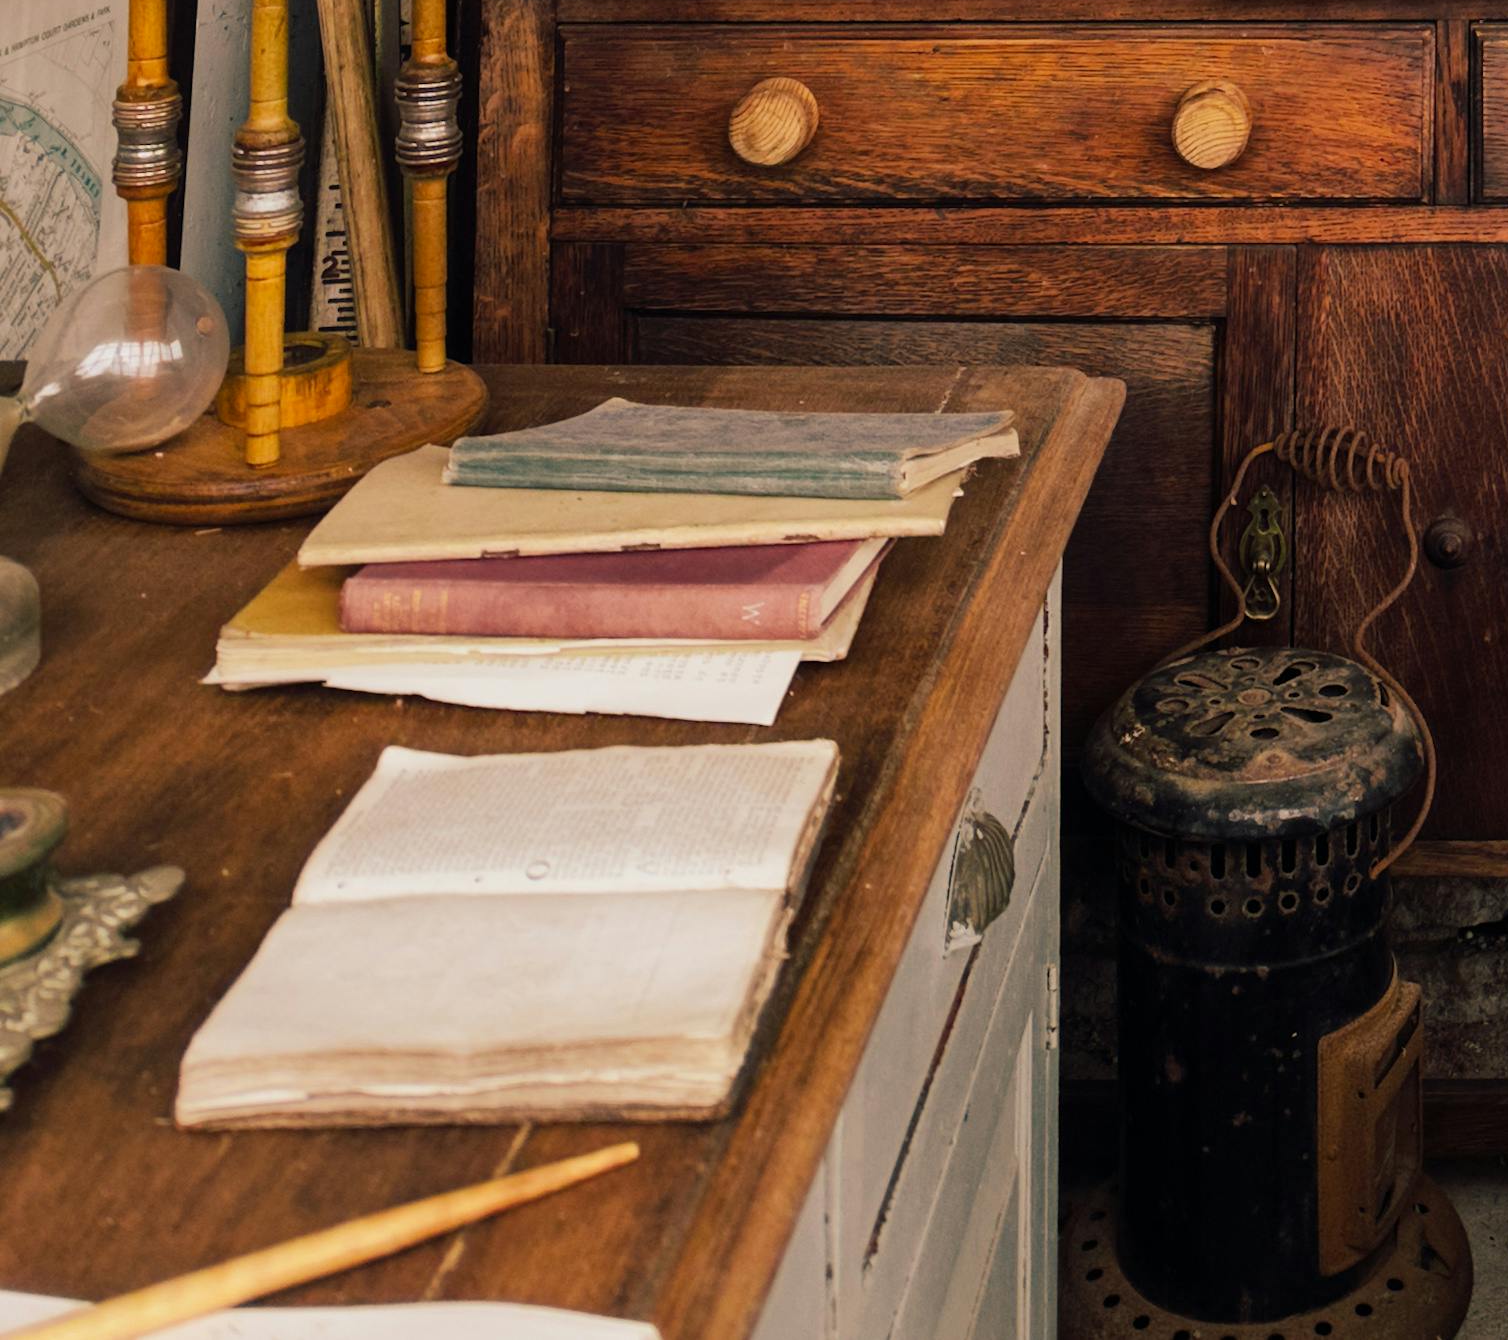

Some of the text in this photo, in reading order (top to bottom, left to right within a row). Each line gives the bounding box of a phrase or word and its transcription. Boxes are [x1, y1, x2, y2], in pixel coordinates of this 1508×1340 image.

[11, 34, 40, 52] HAMPTON
[41, 25, 62, 41] COURT
[62, 14, 90, 32] GARDENS
[97, 6, 111, 16] PARK
[321, 255, 340, 279] 2
